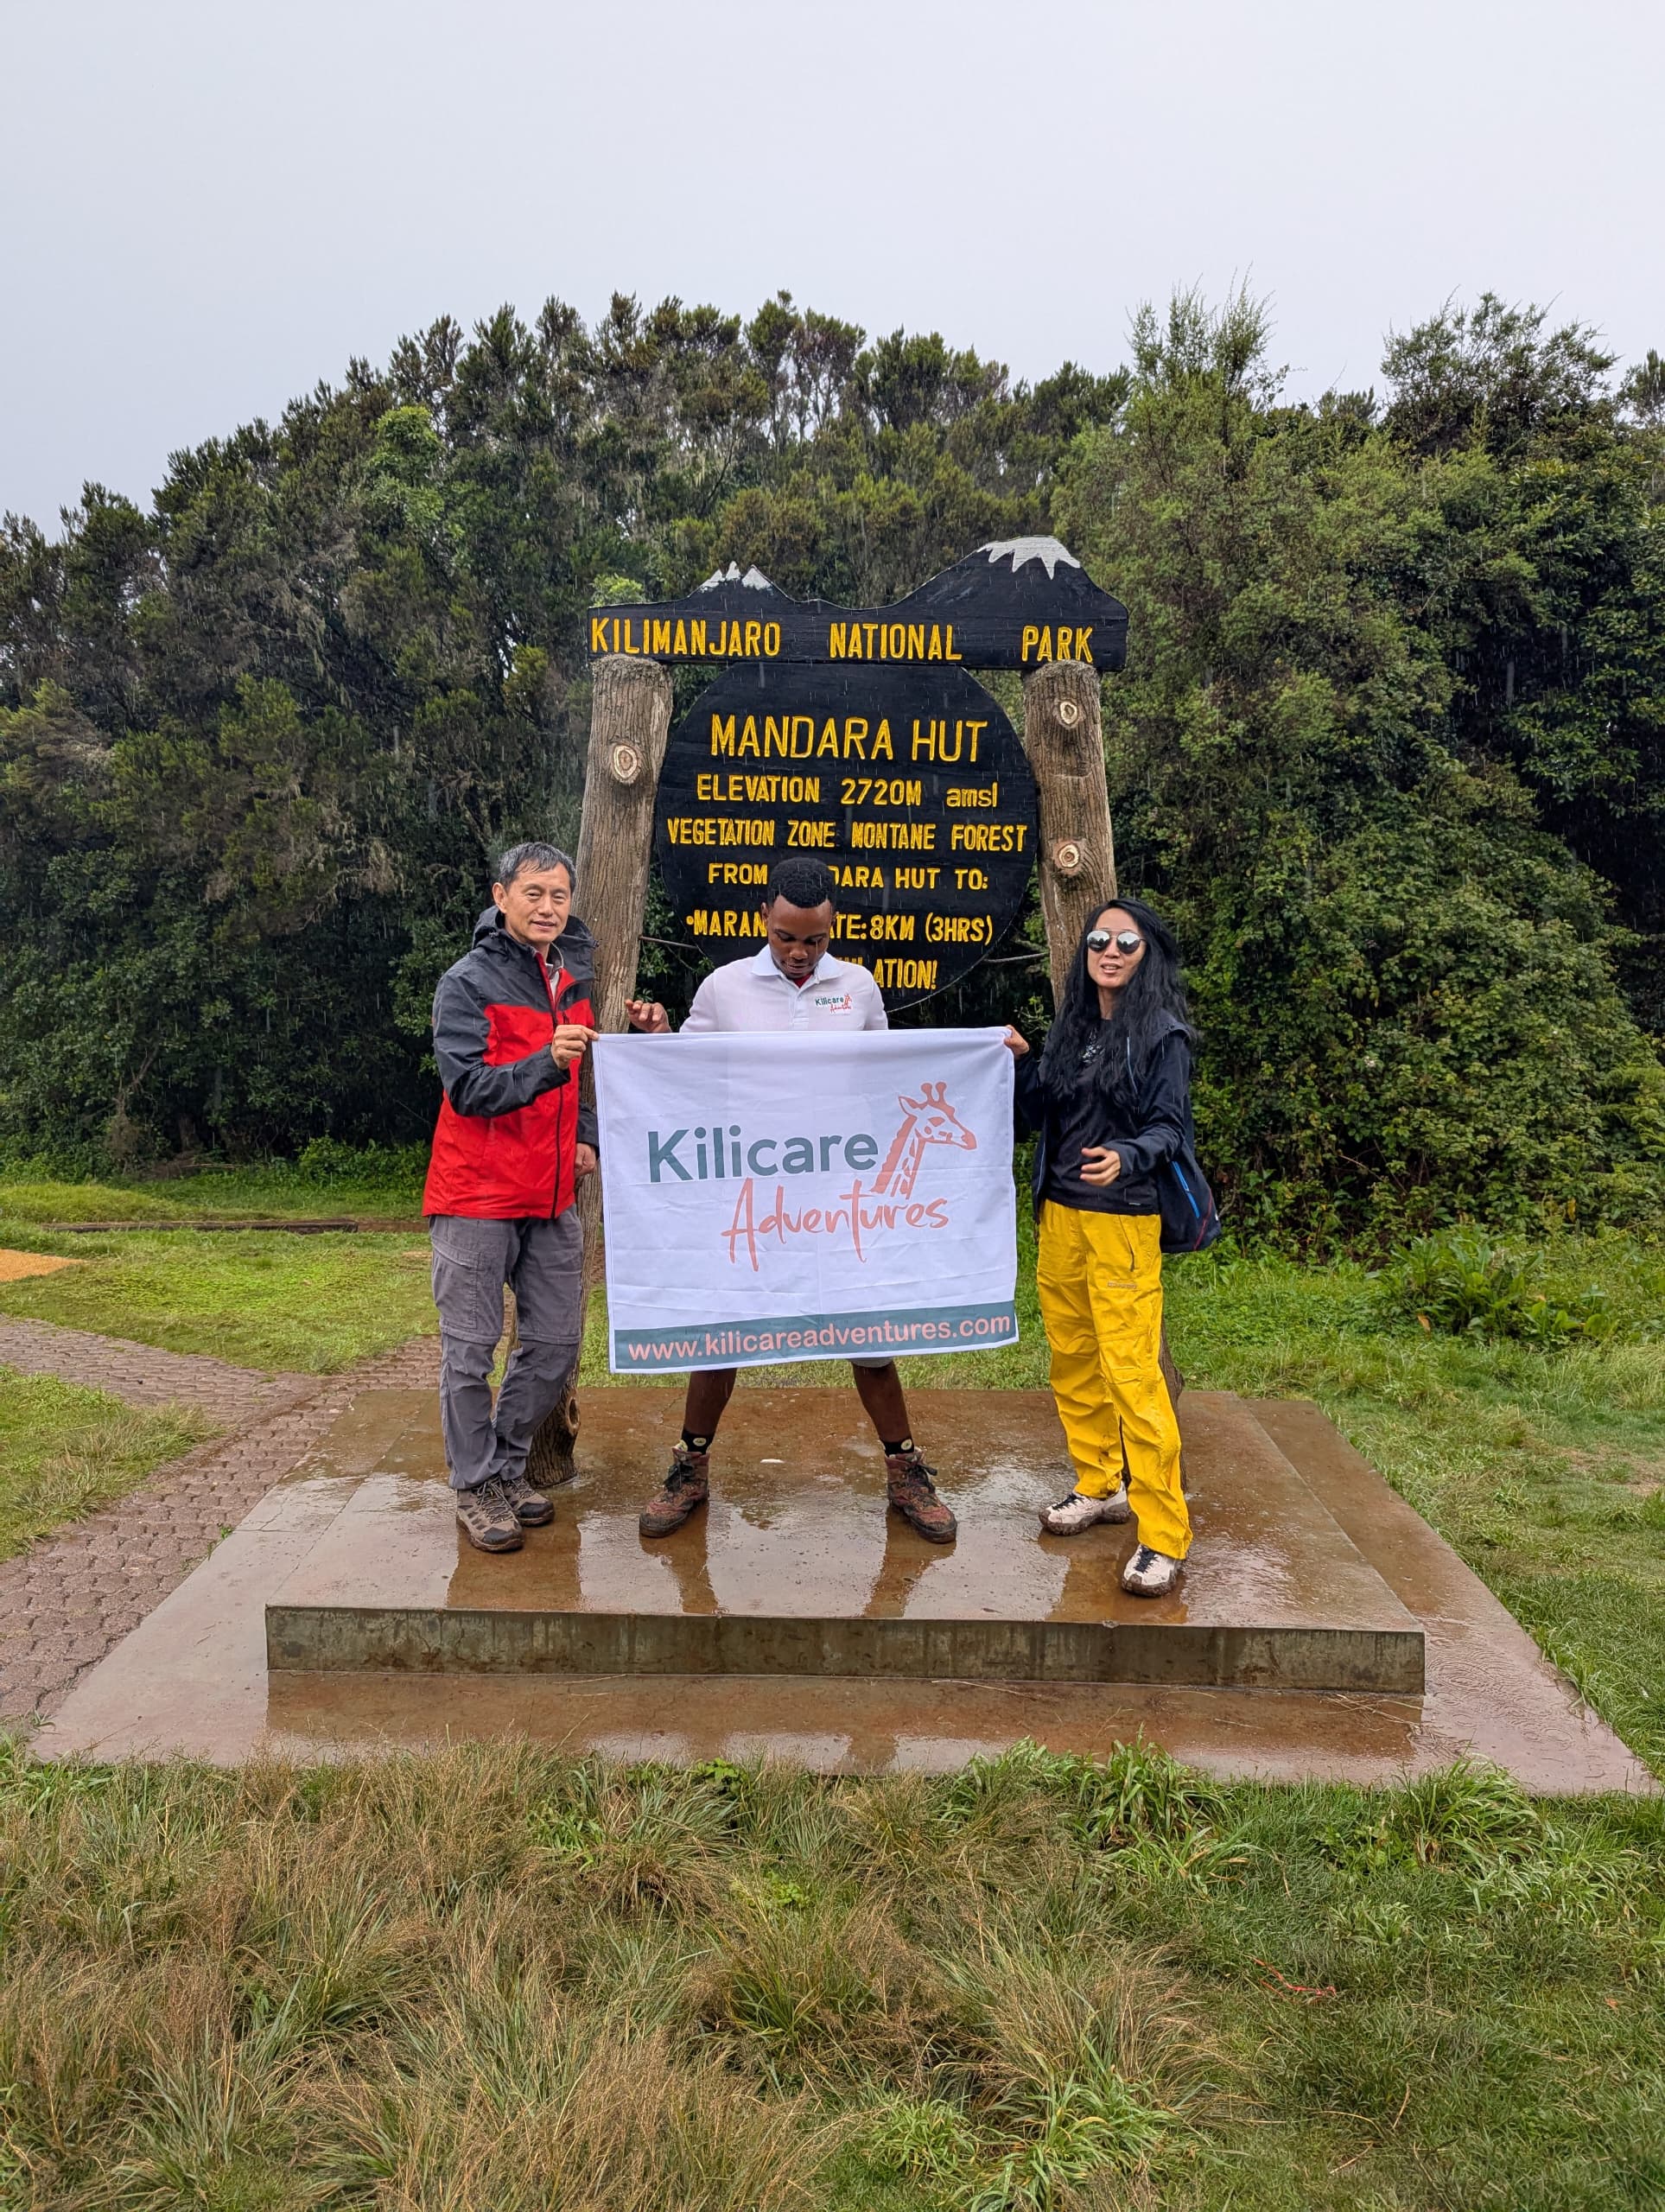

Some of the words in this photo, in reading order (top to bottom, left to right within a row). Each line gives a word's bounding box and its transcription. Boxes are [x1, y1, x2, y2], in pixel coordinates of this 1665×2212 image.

[591, 617, 781, 657] KILIMANJARO
[829, 622, 963, 660] NATIONAL
[1021, 625, 1094, 664] PARK
[710, 714, 893, 760] MANDARA
[912, 719, 988, 762] HUT
[696, 773, 820, 803] ELEVATION
[841, 778, 922, 805] 2720M
[946, 782, 998, 807] amsl
[667, 817, 775, 846] VEGETATION
[787, 820, 836, 848] ZONE
[851, 821, 937, 850] MONTANE
[950, 823, 1027, 852] FOREST
[708, 862, 768, 885] FROM
[895, 868, 940, 889] HUT
[954, 868, 988, 890] TO:
[925, 912, 993, 943] (3HRS)
[648, 1125, 878, 1183] Kilicare
[721, 1178, 949, 1271] Adventures
[628, 1313, 1009, 1360] www.kilicareadventures.com
